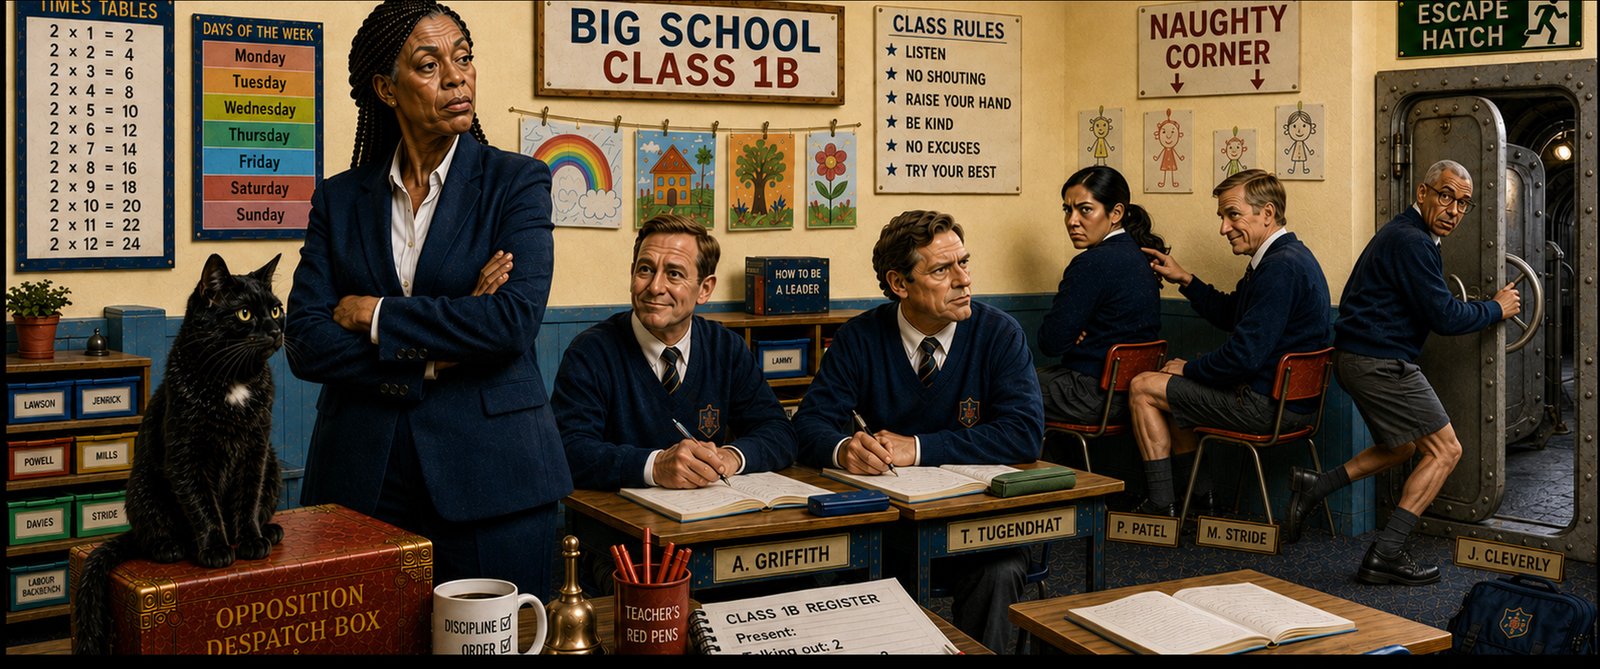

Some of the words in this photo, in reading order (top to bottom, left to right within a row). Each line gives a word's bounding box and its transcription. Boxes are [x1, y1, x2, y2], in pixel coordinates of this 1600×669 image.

[42, 1, 91, 14] TIMES
[99, 1, 157, 19] TABLES
[1419, 1, 1508, 24] ESCAPE
[571, 8, 640, 45] BIG
[659, 12, 820, 53] SCHOOL
[893, 15, 946, 35] CLASS
[952, 19, 1004, 40] RULES
[1151, 4, 1287, 40] NAUGHTY
[50, 24, 58, 37] 2
[87, 26, 92, 39] 1
[125, 29, 133, 42] 2
[204, 22, 233, 36] DAYS
[238, 24, 252, 37] OF
[257, 26, 278, 38] THE
[283, 27, 313, 41] WEEK
[1423, 25, 1503, 50] HATCH
[50, 43, 59, 57] 2
[87, 46, 94, 59] 2
[125, 48, 134, 61] 4
[235, 48, 285, 67] Monday
[906, 45, 945, 60] LISTEN
[1166, 40, 1270, 69] CORNER
[50, 63, 58, 76] 2
[87, 65, 94, 78] 3
[125, 67, 133, 80] 6
[604, 50, 735, 87] CLASS
[753, 56, 799, 88] 1B
[906, 69, 923, 82] NO
[927, 70, 986, 85] SHOUTING
[50, 82, 59, 96] 2
[86, 84, 95, 97] 4
[125, 86, 133, 99] 8
[233, 74, 286, 93] Tuesday
[906, 93, 939, 106] RAISE
[944, 95, 974, 108] YOUR
[979, 97, 1011, 109] HAND
[50, 102, 58, 115] 2
[87, 104, 94, 116] 5
[123, 105, 138, 118] 10
[224, 101, 296, 119] Wednesday
[50, 121, 59, 135] 2
[87, 123, 95, 136] 6
[123, 124, 137, 137] 12
[906, 116, 920, 129] BE
[926, 117, 953, 130] KIND
[229, 127, 290, 145] Thursday
[50, 141, 59, 154] 2
[87, 142, 94, 155] 7
[122, 143, 137, 156] 14
[906, 140, 923, 153] NO
[928, 141, 980, 155] EXCUSES
[50, 160, 58, 173] 2
[87, 161, 95, 174] 8
[123, 162, 137, 174] 16
[240, 154, 280, 172] Friday
[905, 164, 928, 177] TRY
[932, 165, 963, 178] YOUR
[968, 166, 996, 178] BEST
[50, 179, 58, 193] 2
[87, 180, 95, 193] 9
[122, 181, 136, 193] 18
[231, 181, 289, 198] Saturday
[50, 199, 59, 212] 2
[84, 199, 99, 212] 10
[123, 199, 141, 212] 20
[237, 207, 285, 224] Sunday
[50, 218, 58, 231] 2
[84, 218, 95, 231] 11
[123, 218, 140, 231] 22
[50, 237, 59, 251] 2
[84, 237, 98, 250] 12
[123, 237, 140, 250] 24
[776, 270, 795, 278] HOW
[798, 269, 808, 278] TO
[811, 269, 821, 278] BE
[776, 285, 783, 294] A
[786, 284, 819, 294] LEADER
[24, 399, 55, 409] LAWSON
[93, 396, 121, 405] JENRICK
[25, 456, 54, 466] POWELL
[96, 451, 118, 460] MILLS
[27, 517, 53, 529] DAVIES
[92, 509, 118, 520] STRIDE
[961, 529, 972, 544] T.
[978, 517, 1062, 541] TUGENDHAT
[1117, 521, 1127, 533] P.
[1132, 522, 1167, 538] PATEL
[1207, 526, 1220, 539] M.
[1226, 528, 1267, 545] STRIDE
[732, 555, 749, 573] A.
[755, 545, 829, 570] GRIFFITH
[1467, 546, 1480, 561] J.
[1484, 548, 1551, 572] CLEVERLY
[29, 576, 54, 586] LABOUR
[215, 583, 365, 630] OPPOSITION
[625, 604, 680, 622] TEACHER'S
[726, 609, 776, 624] CLASS
[781, 606, 800, 616] 1B
[805, 594, 880, 613] REGISTER
[207, 617, 326, 655] DESPATCH
[335, 610, 380, 636] BOX
[444, 618, 498, 636] DISCIPLINE
[626, 627, 648, 643] RED
[651, 627, 679, 643] PENS
[736, 628, 796, 644] Present:
[462, 641, 496, 655] ORDER
[802, 642, 830, 654] out:
[832, 640, 843, 650] 2
